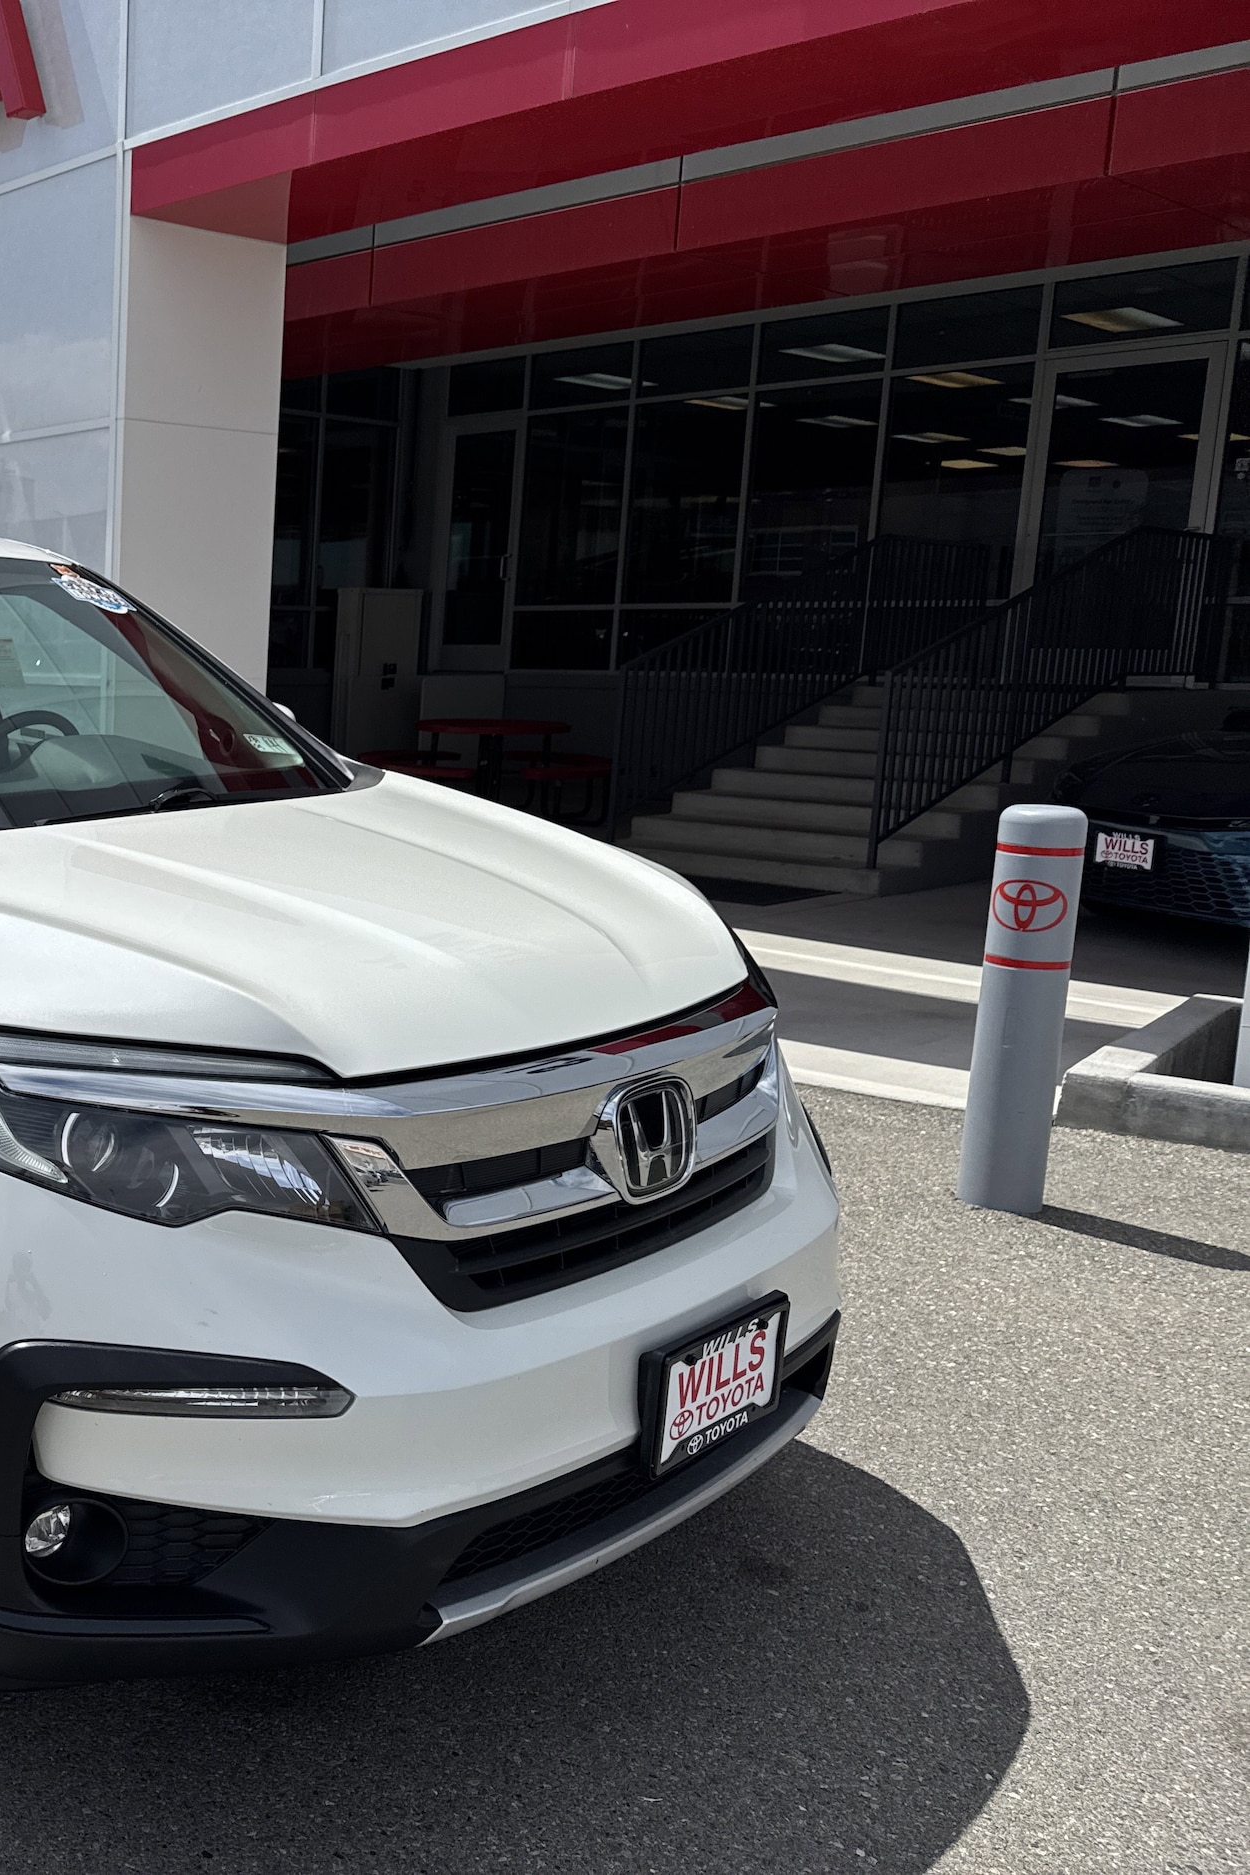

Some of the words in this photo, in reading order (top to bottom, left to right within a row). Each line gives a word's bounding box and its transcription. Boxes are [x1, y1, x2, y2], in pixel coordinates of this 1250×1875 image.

[1104, 837, 1149, 855] WILLS
[1114, 852, 1148, 864] TOYOTA
[678, 1329, 767, 1410] WILLS
[695, 1372, 765, 1426] TOYOTA
[705, 1411, 749, 1445] TOYOTA
